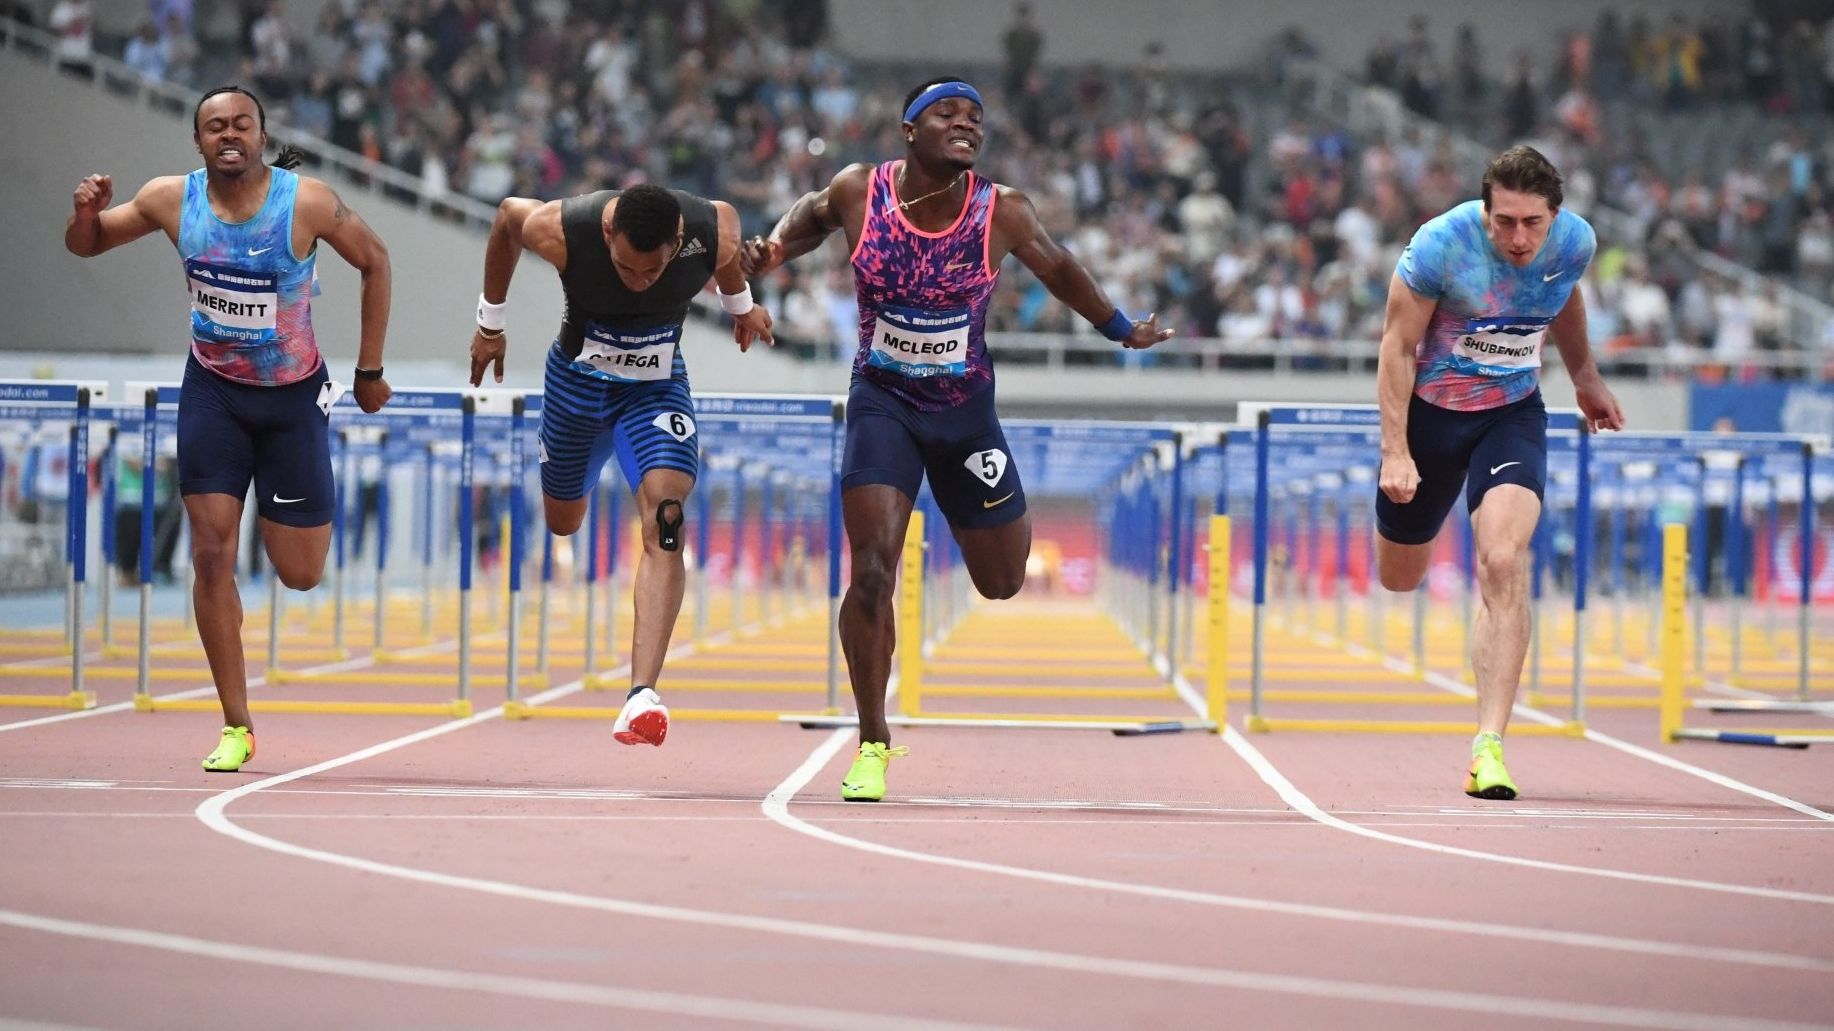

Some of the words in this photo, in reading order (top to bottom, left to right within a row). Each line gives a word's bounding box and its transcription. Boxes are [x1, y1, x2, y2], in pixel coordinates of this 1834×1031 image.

[679, 247, 707, 258] adidas
[197, 289, 268, 318] MERRITT
[213, 325, 263, 340] Shanghai
[883, 332, 958, 355] MCLEOD
[1463, 337, 1535, 357] SHUBENKOV
[670, 414, 686, 436] 6
[981, 451, 997, 480] 5
